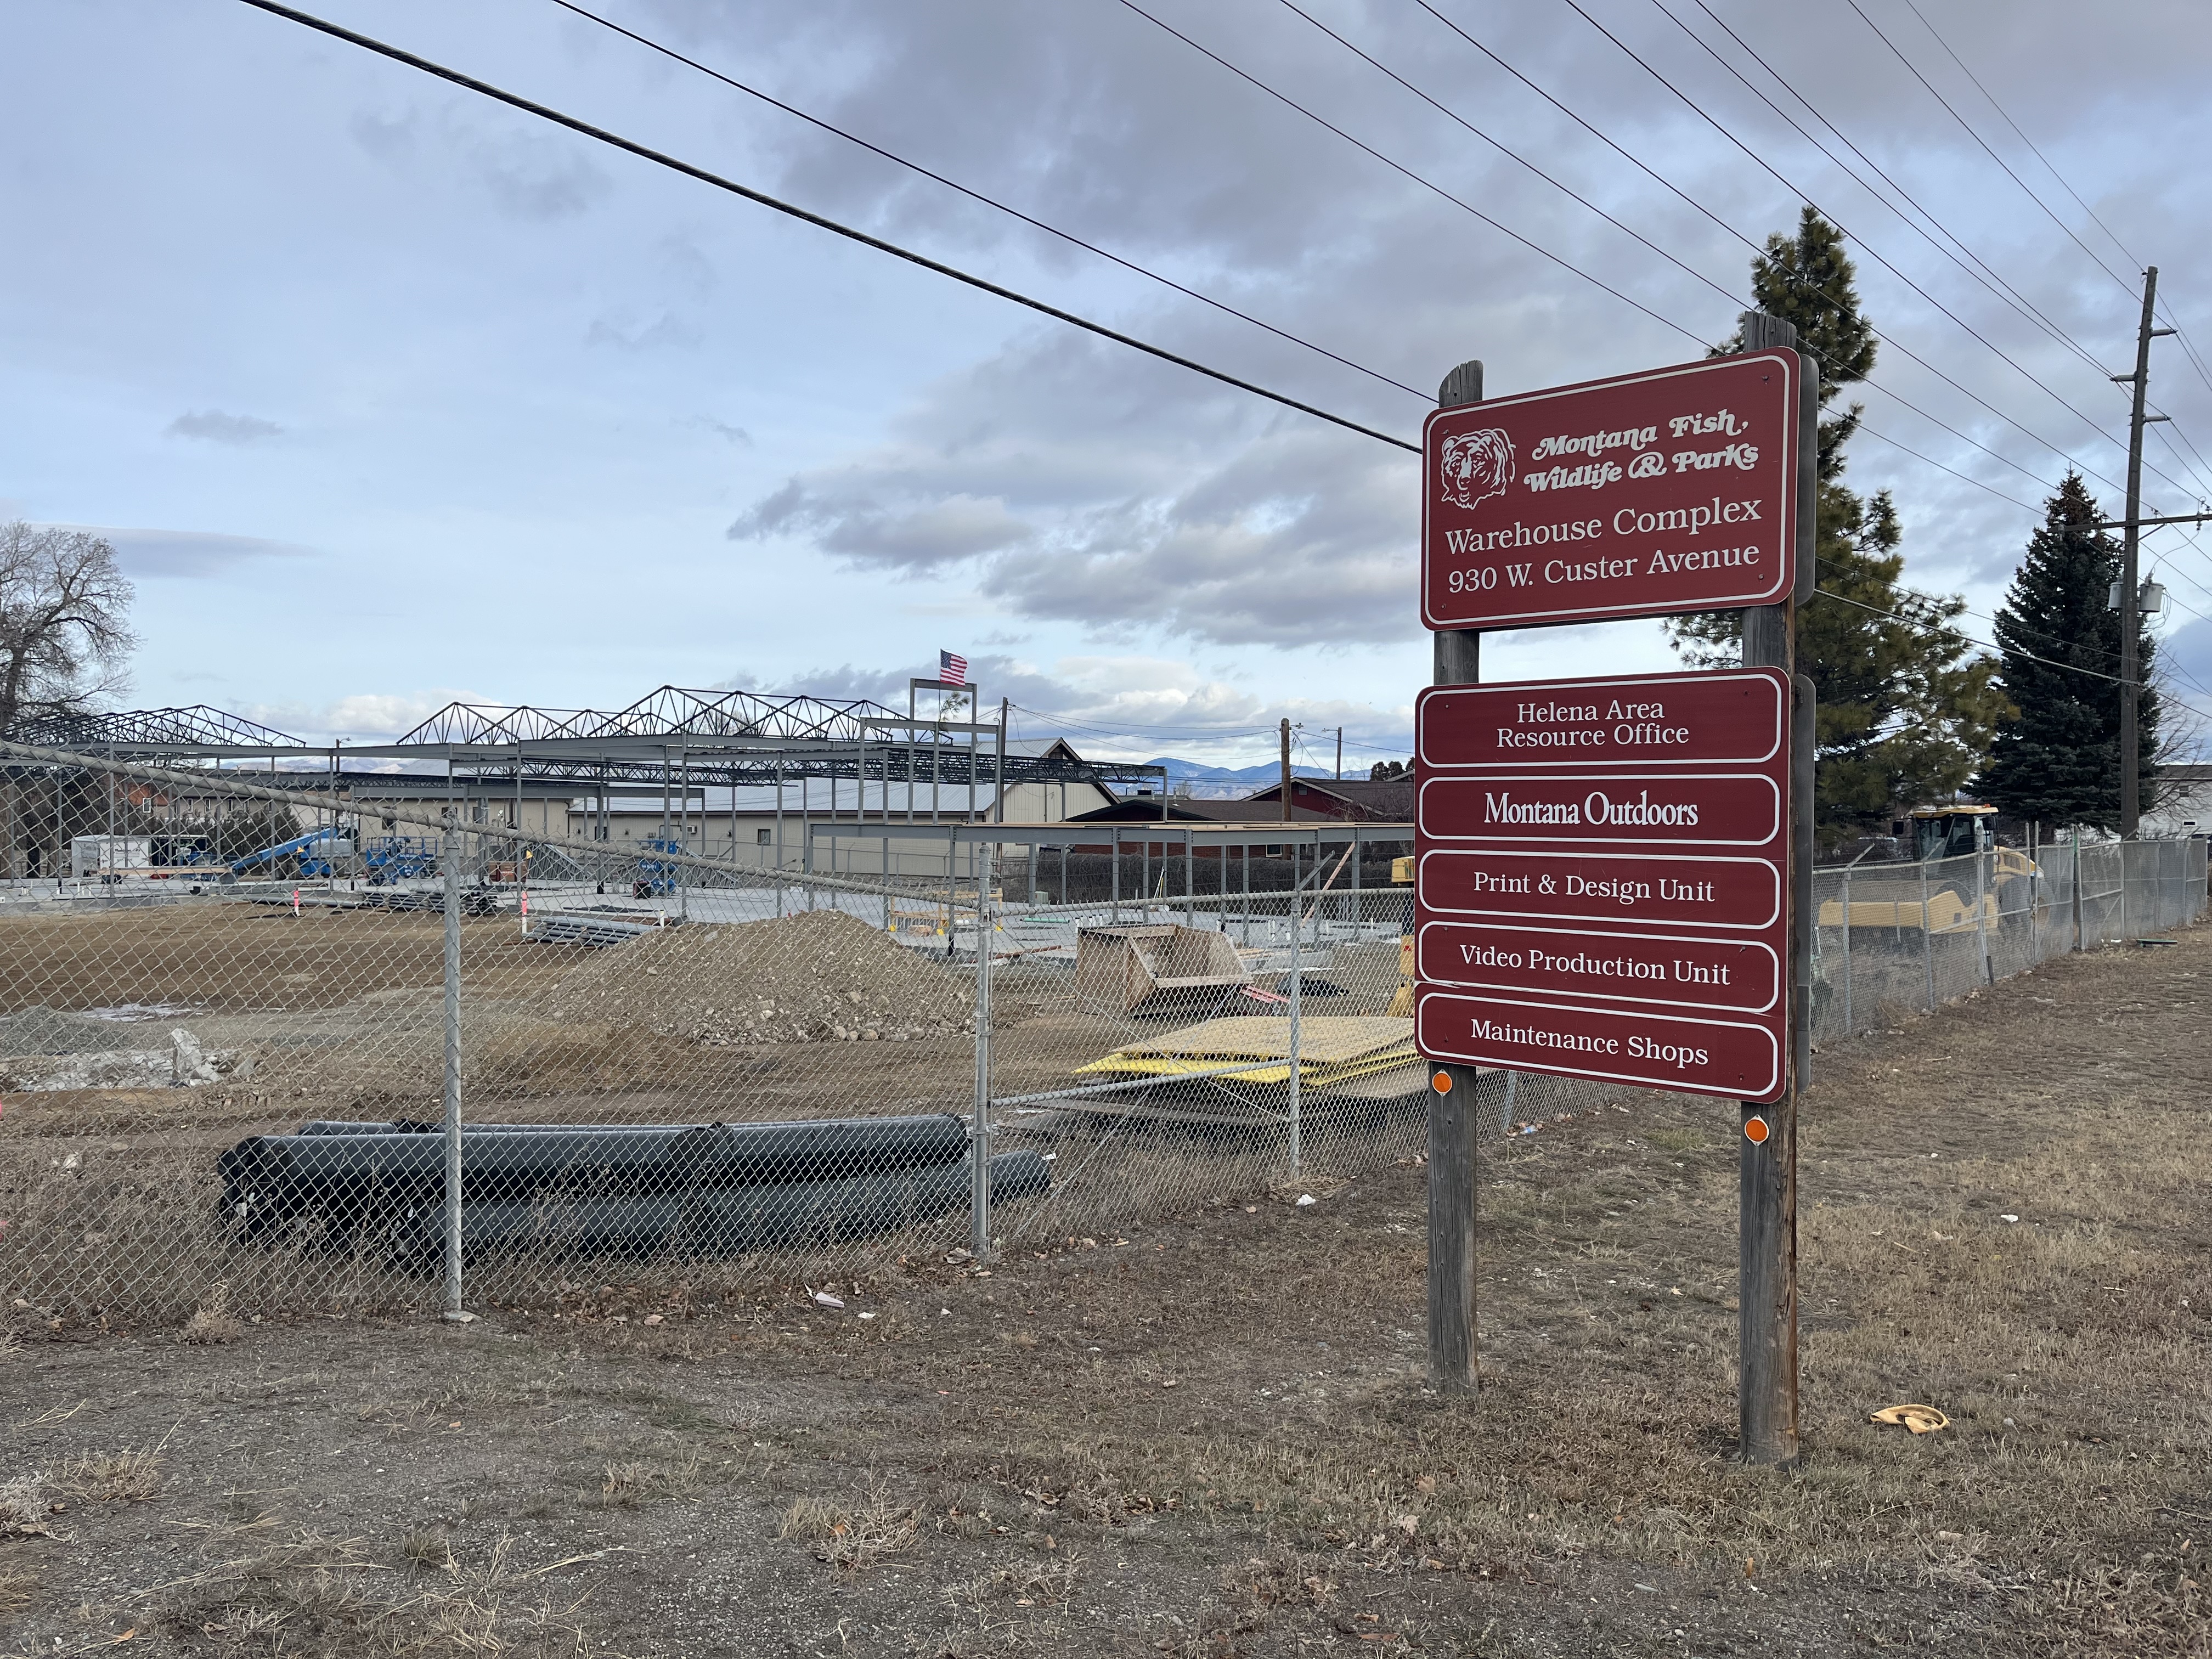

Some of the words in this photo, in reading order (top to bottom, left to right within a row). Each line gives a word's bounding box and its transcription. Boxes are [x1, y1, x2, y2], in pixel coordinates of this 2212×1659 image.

[1532, 426, 1658, 461] Montana
[1668, 408, 1748, 438] Fish,
[1523, 461, 1623, 492] Wildlife
[1628, 452, 1667, 479] &
[1444, 519, 1602, 555] Warehouse
[1613, 496, 1762, 535] Complex
[1449, 567, 1497, 593] 930
[1505, 563, 1533, 588] W.
[1544, 556, 1638, 584] Custer
[1646, 546, 1759, 574] Avenue
[1517, 702, 1599, 723] Helena
[1605, 699, 1665, 720] Area
[1497, 728, 1605, 747] Resource
[1614, 723, 1689, 745] Office
[1484, 792, 1581, 825] Montana
[1584, 789, 1699, 826] Outdoors
[1474, 872, 1531, 894] Print
[1538, 874, 1557, 894] &
[1565, 875, 1651, 905] Design
[1658, 879, 1716, 902] Unit
[1459, 944, 1522, 968] Video
[1528, 949, 1667, 980] Production
[1673, 960, 1731, 985] Unit
[1471, 1018, 1619, 1054] Maintenance
[1627, 1036, 1708, 1069] Shops
